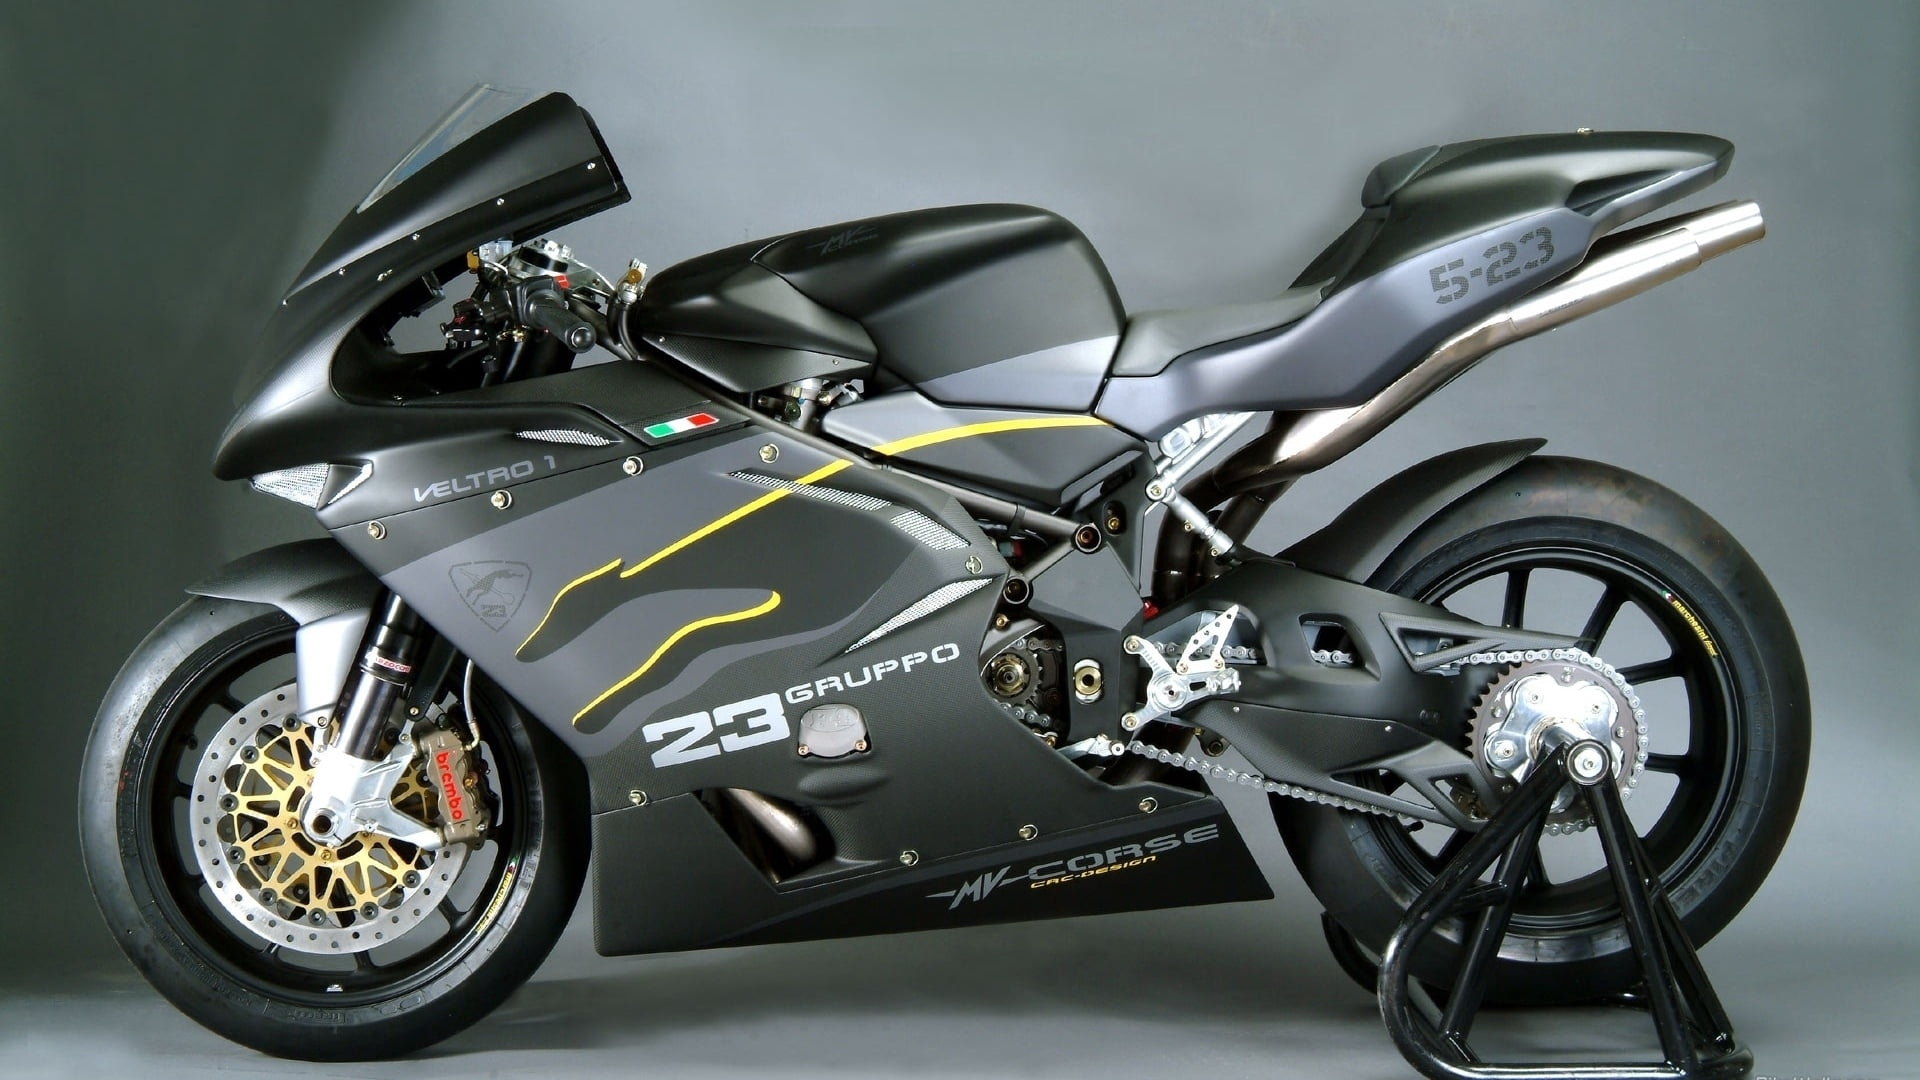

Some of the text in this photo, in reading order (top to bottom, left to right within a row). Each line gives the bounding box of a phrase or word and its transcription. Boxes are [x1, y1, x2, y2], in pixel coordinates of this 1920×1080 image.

[1429, 226, 1555, 304] 5-23
[413, 455, 557, 502] VELTRO 1
[1672, 600, 1709, 640] marchesini
[784, 642, 960, 704] GRUPPO
[641, 692, 791, 769] 23
[436, 751, 462, 820] brembo
[1028, 823, 1219, 881] CORSE
